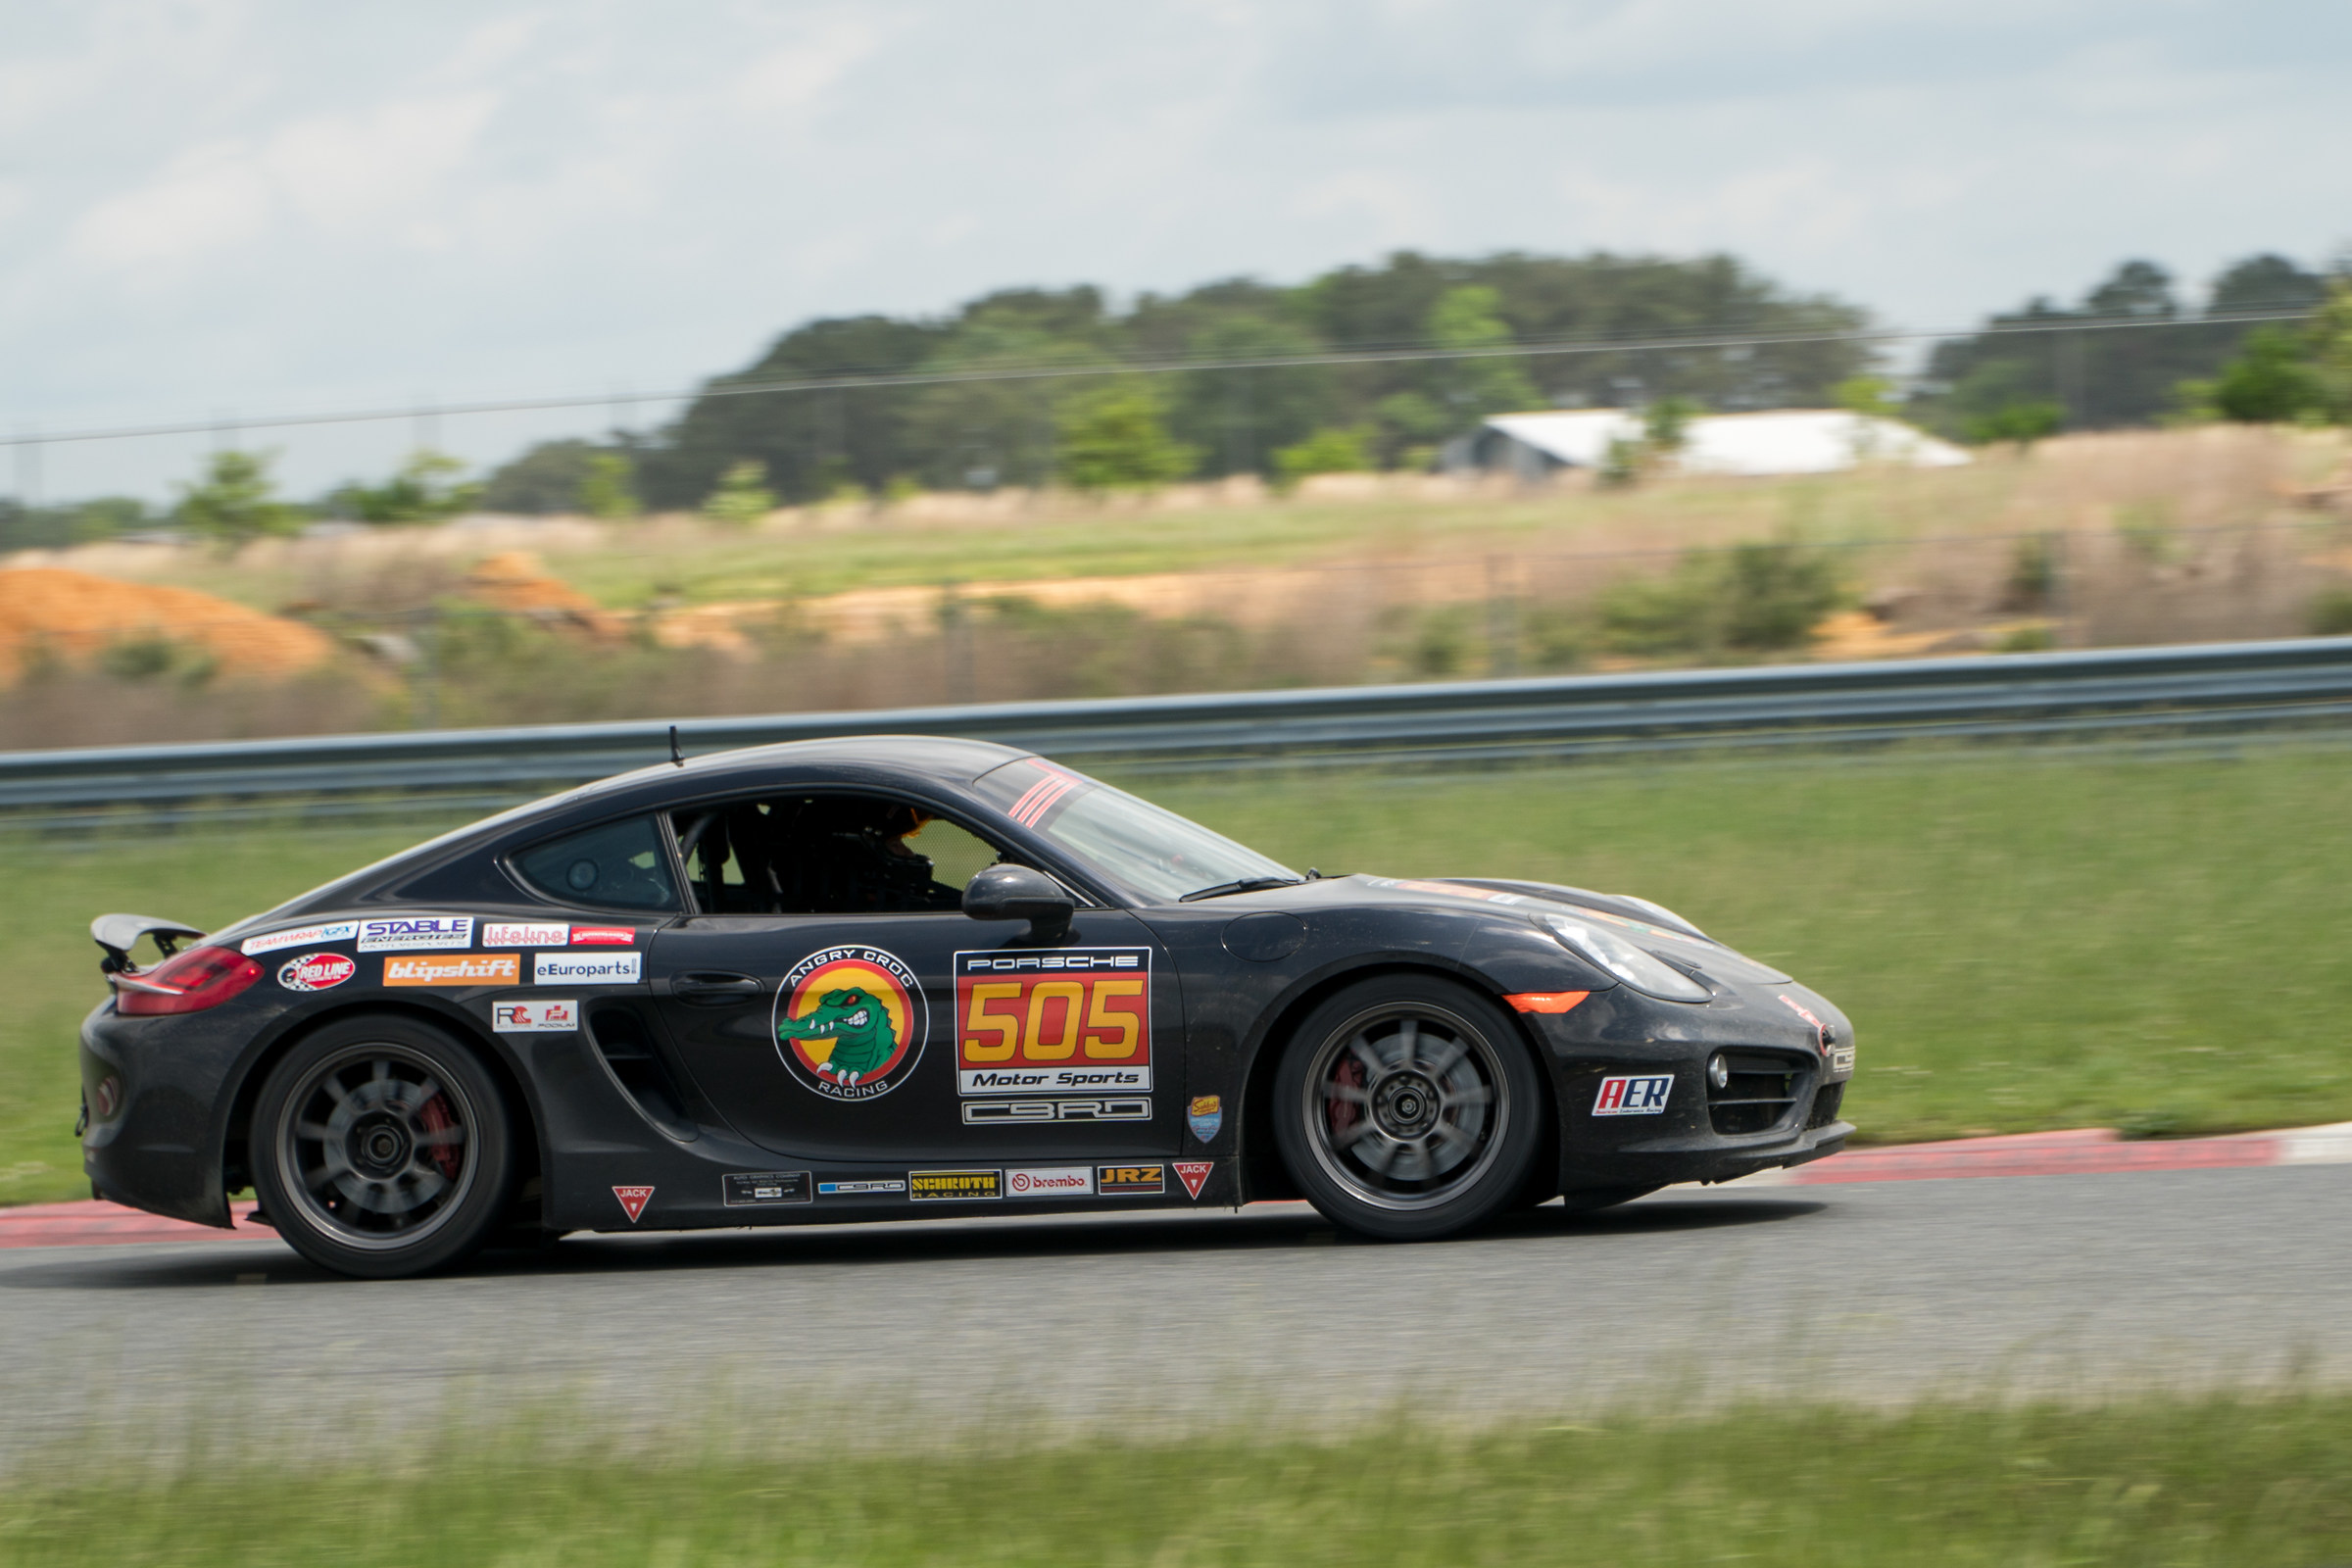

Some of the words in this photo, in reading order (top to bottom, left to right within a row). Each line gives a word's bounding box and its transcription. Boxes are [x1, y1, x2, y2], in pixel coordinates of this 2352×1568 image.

[367, 919, 468, 936] STABLE
[299, 964, 323, 979] RED
[323, 961, 351, 976] LINE
[388, 959, 516, 982] blipshift
[537, 960, 630, 977] eEuroparts
[790, 949, 856, 987] ANGRY
[862, 950, 913, 988] CROC
[967, 956, 1139, 970] PORSCHE
[963, 979, 1145, 1063] 505
[972, 1072, 1050, 1087] Motor
[1055, 1071, 1140, 1087] Sports
[817, 1080, 889, 1098] RACING
[1598, 1078, 1670, 1108] AER
[1101, 1167, 1162, 1184] JRZ
[1180, 1164, 1206, 1174] JACK
[911, 1176, 996, 1191] SCHROTH
[1033, 1176, 1085, 1188] brembo
[620, 1189, 647, 1198] JACK
